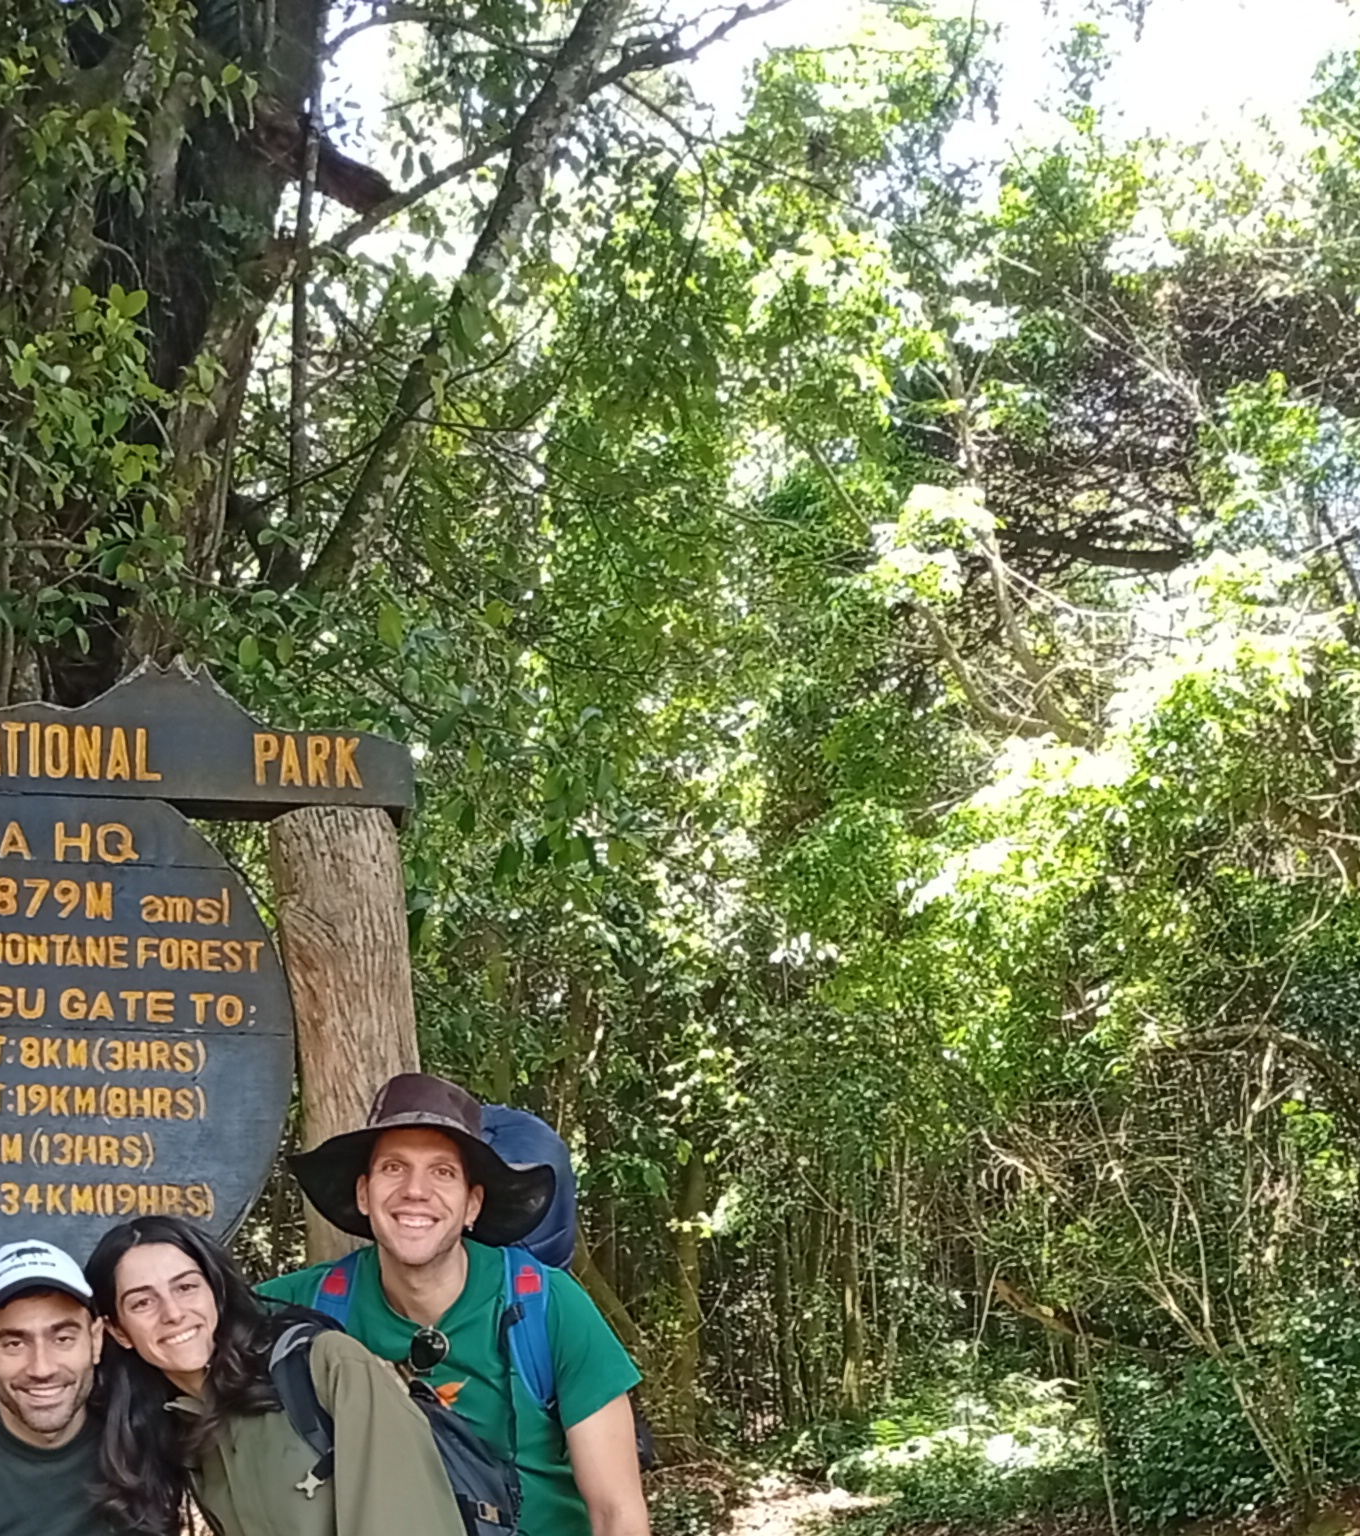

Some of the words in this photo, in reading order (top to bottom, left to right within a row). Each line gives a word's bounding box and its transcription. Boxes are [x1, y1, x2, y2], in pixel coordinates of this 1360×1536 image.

[252, 732, 363, 789] PARK
[53, 821, 140, 864] HQ
[139, 887, 230, 928] amsl
[136, 935, 266, 973] FOREST
[59, 987, 176, 1024] GATE
